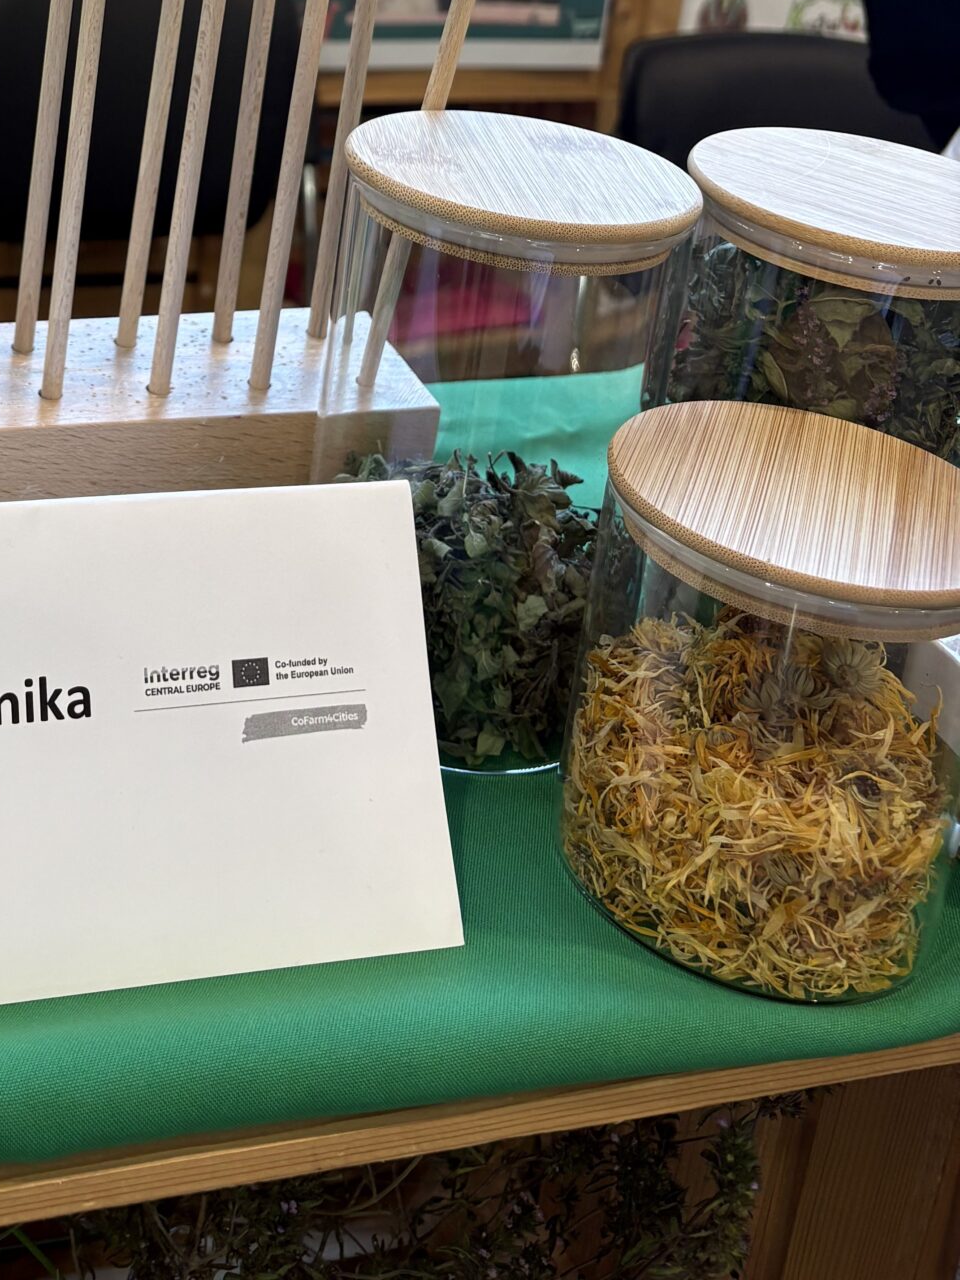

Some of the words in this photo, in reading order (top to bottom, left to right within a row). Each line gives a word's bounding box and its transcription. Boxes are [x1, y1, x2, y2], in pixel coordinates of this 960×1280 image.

[274, 658, 316, 669] Co-funded
[318, 657, 328, 667] by
[143, 664, 220, 684] Interreg
[276, 671, 289, 680] the
[290, 669, 329, 679] European
[330, 666, 354, 675] Union
[145, 686, 184, 696] CENTRAL
[186, 682, 221, 693] EUROPE
[291, 711, 359, 727] CoFarm4Cities
